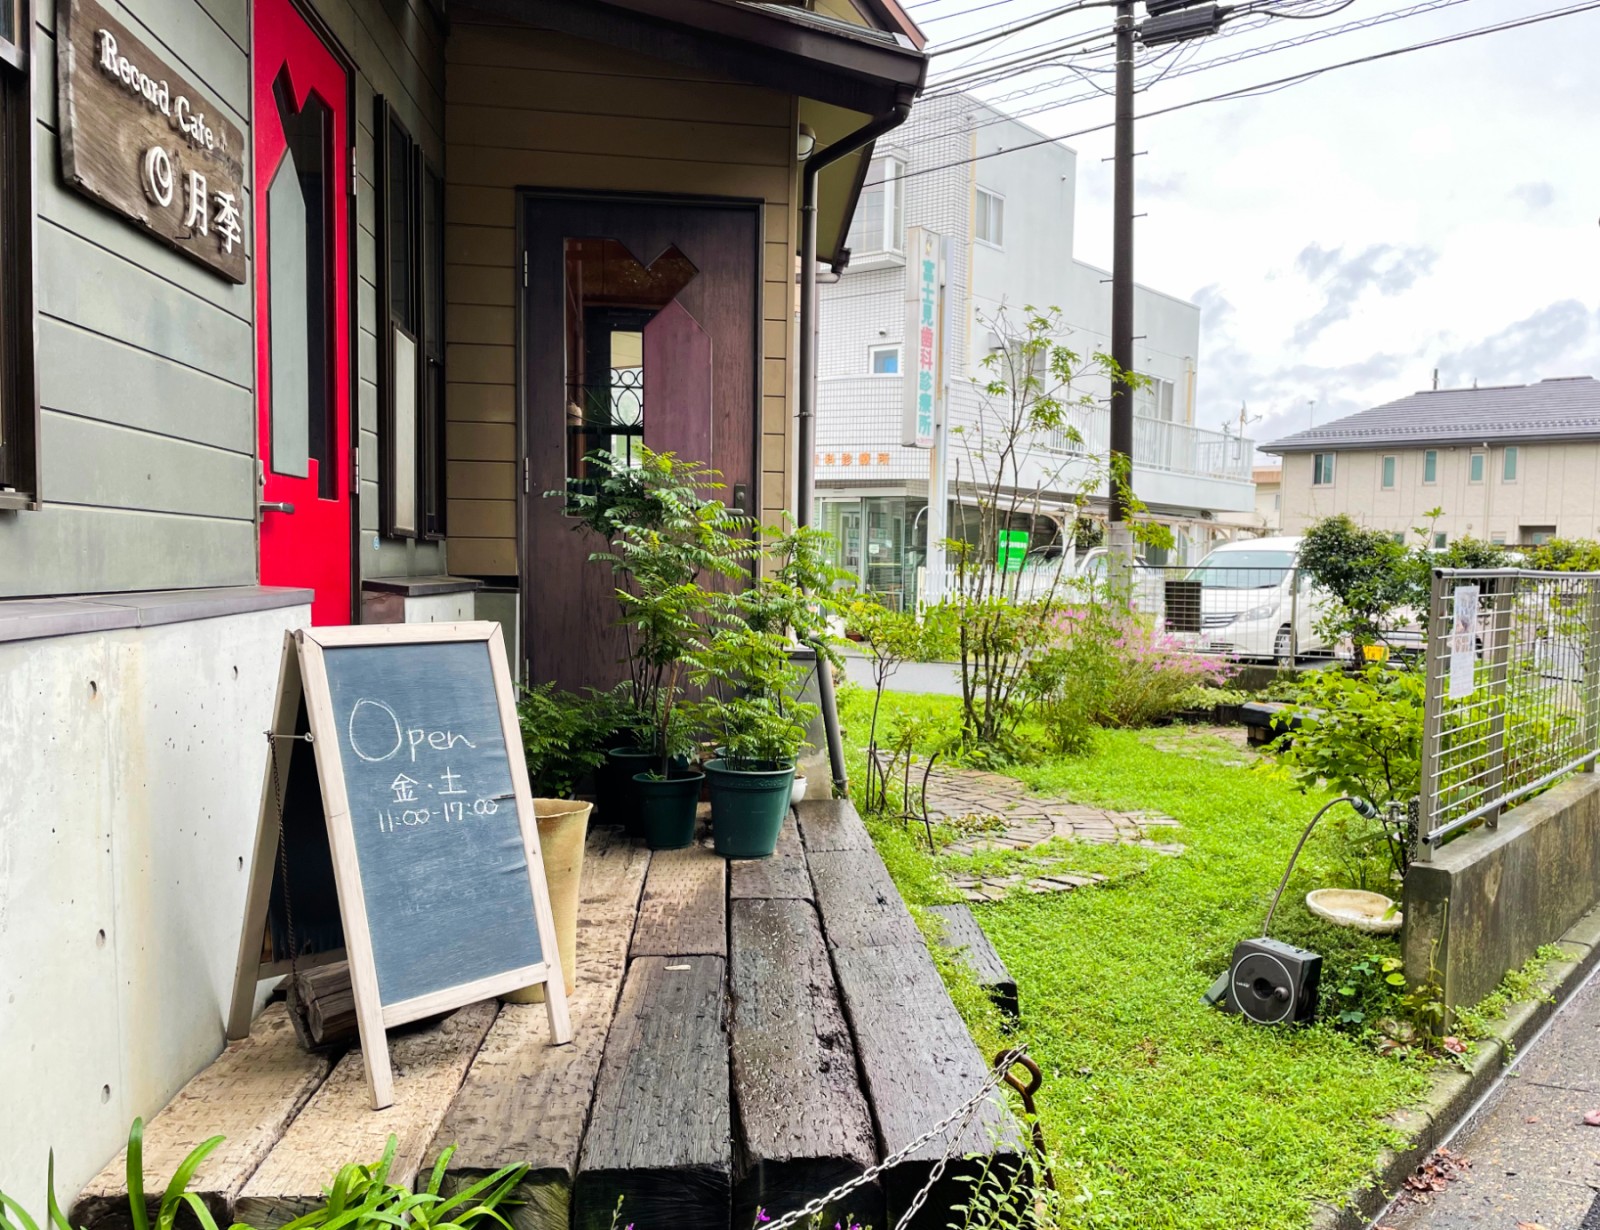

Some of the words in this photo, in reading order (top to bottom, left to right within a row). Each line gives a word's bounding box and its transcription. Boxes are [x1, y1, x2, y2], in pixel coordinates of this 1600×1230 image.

[97, 28, 170, 117] Record
[174, 95, 214, 150] Cafe
[918, 258, 936, 436] 富士見歯科診療所
[349, 697, 477, 762] Open
